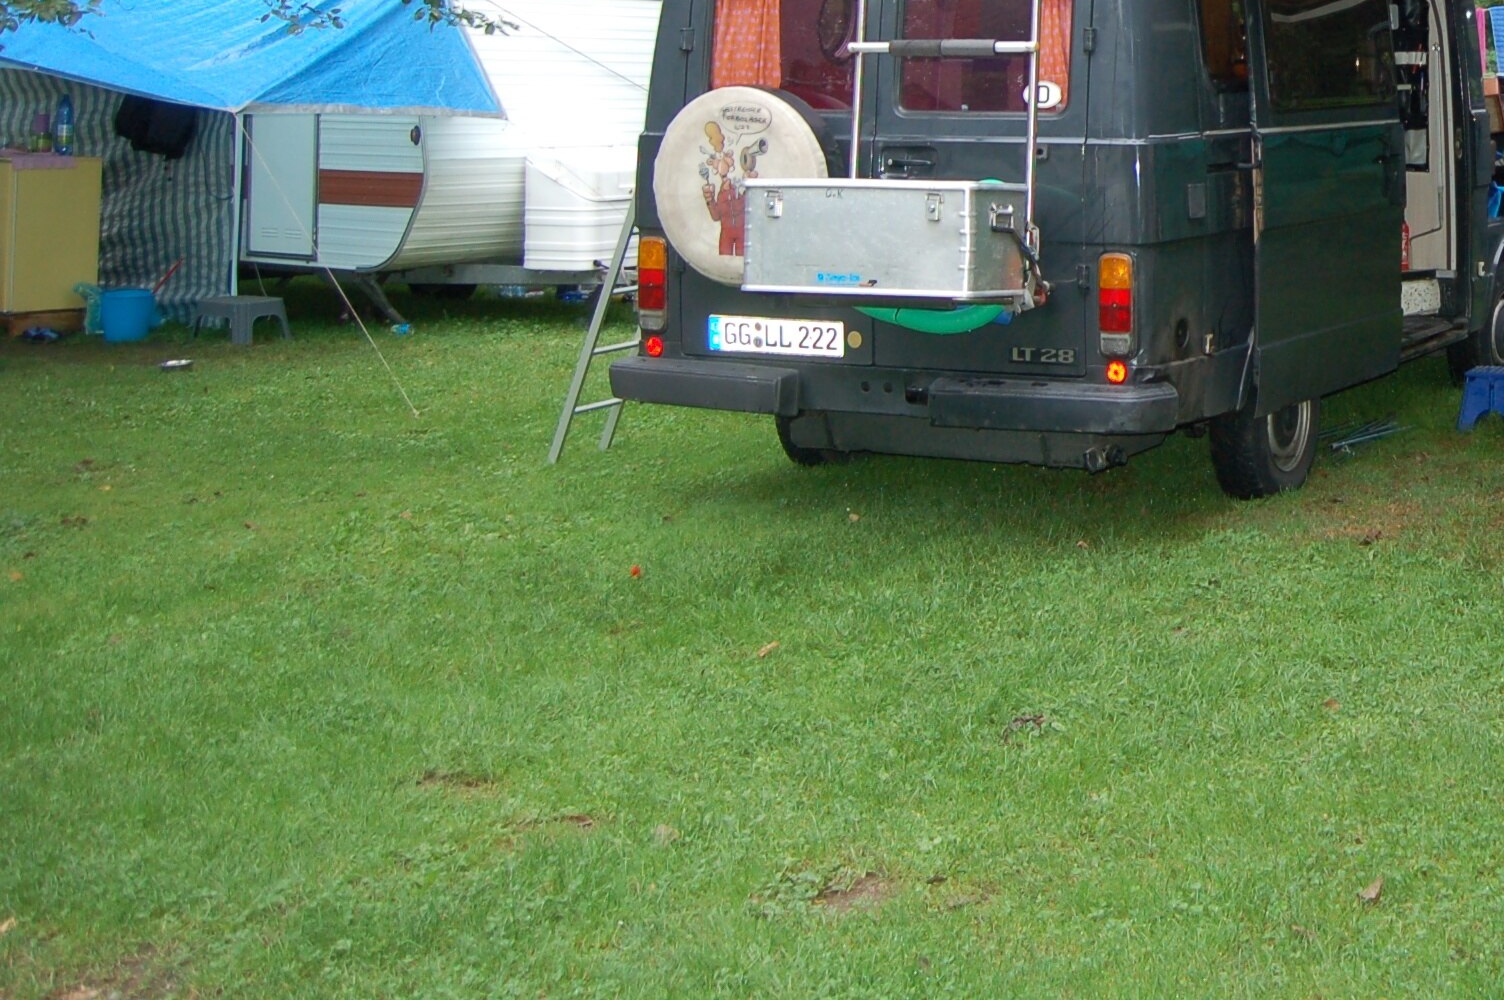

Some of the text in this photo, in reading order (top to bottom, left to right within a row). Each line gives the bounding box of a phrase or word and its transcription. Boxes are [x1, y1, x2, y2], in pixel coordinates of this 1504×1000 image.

[1036, 84, 1050, 104] D
[724, 322, 838, 351] GG LL 222
[1012, 346, 1075, 364] LT 28
